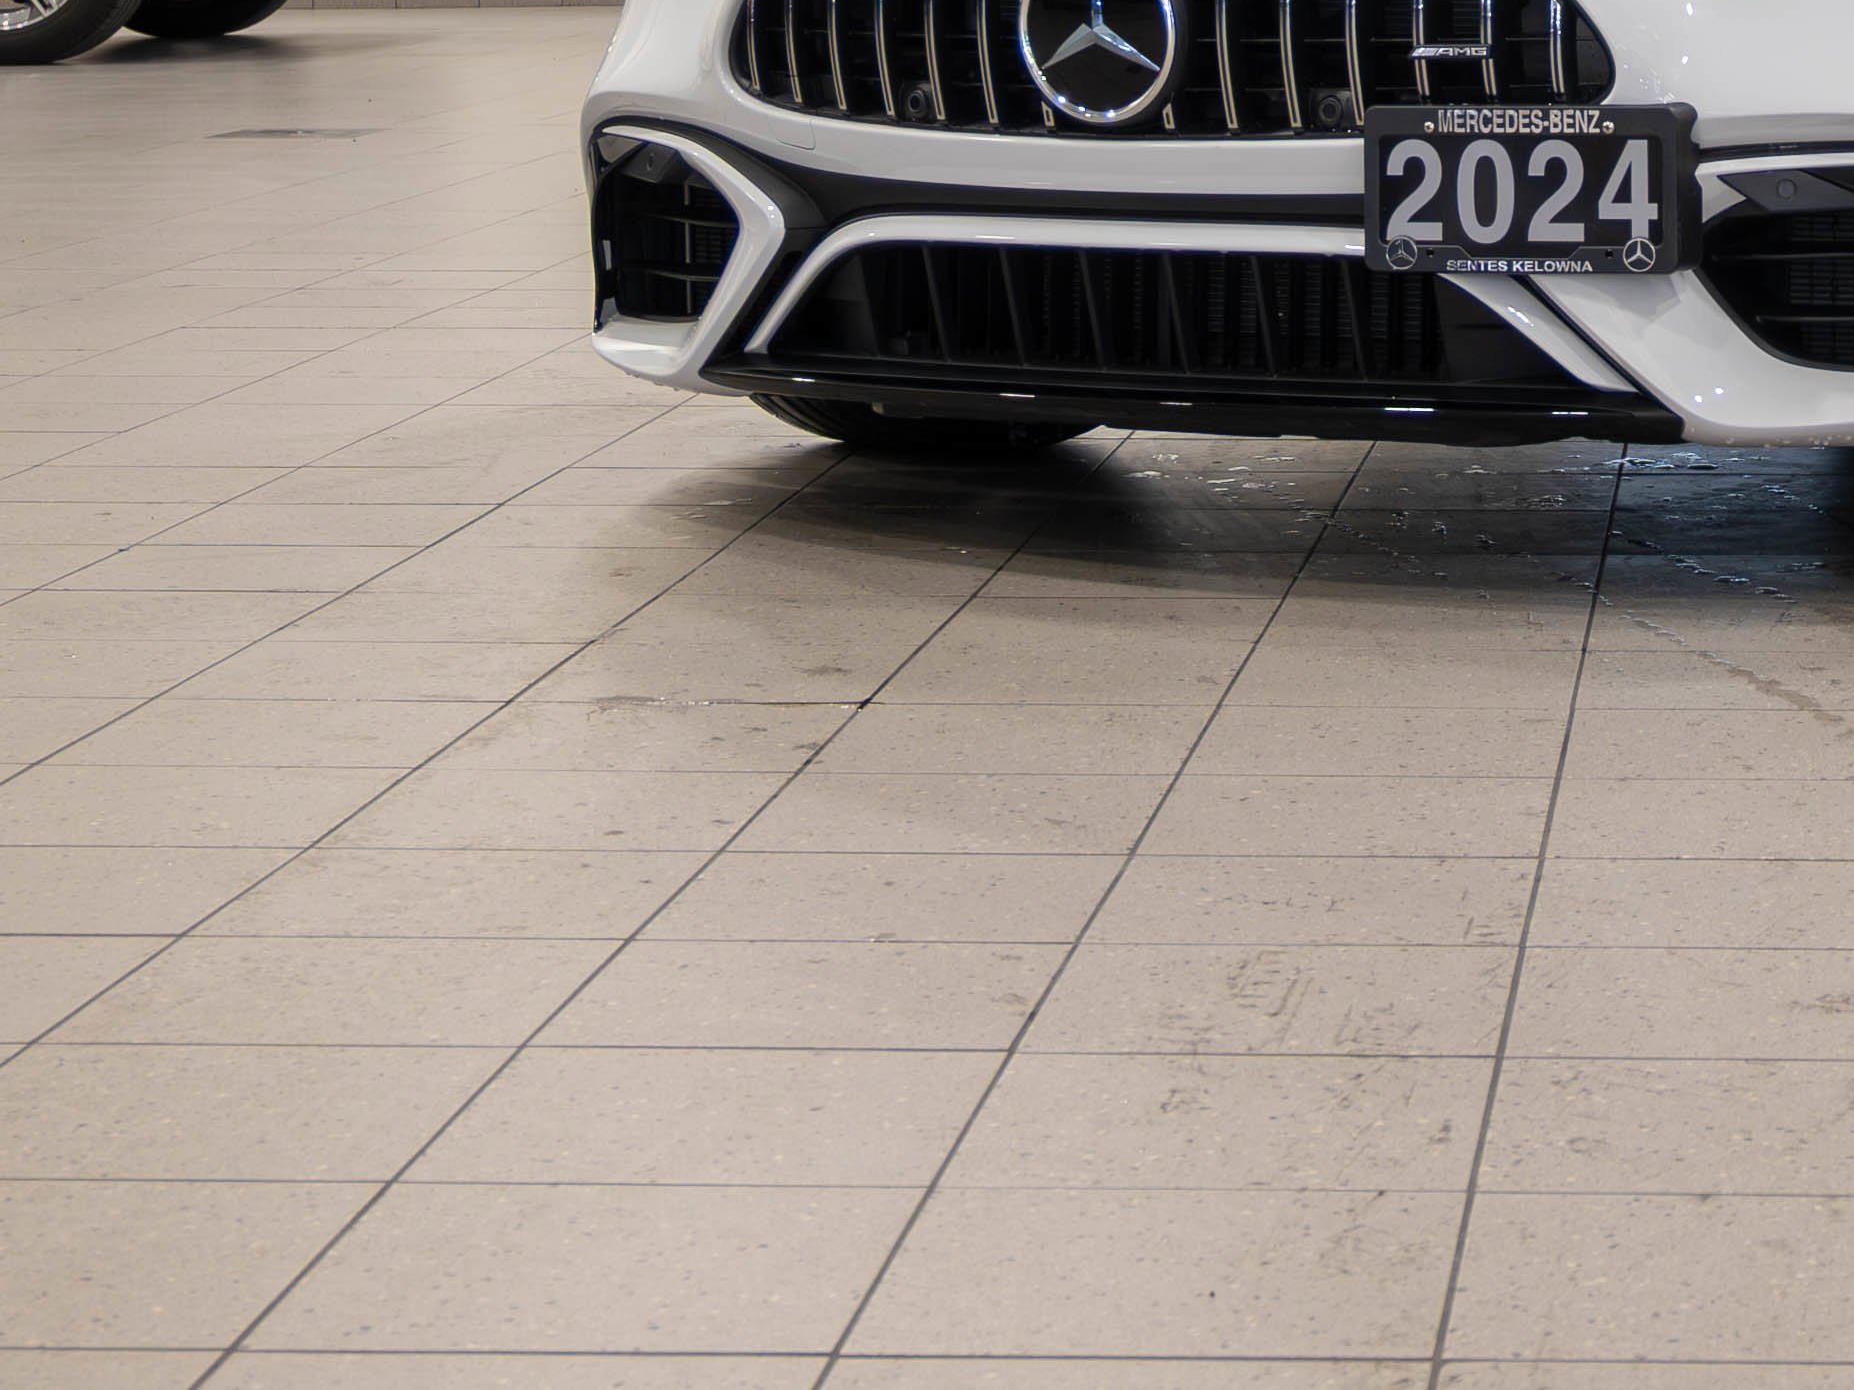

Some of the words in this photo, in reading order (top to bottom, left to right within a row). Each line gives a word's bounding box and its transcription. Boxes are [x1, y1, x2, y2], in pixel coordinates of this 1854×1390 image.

[1436, 47, 1487, 56] AMG
[1438, 109, 1600, 134] MERCEDES-BENZ
[1385, 138, 1658, 244] 2024
[1446, 260, 1508, 272] SENTES
[1512, 260, 1593, 272] KELOWNA
